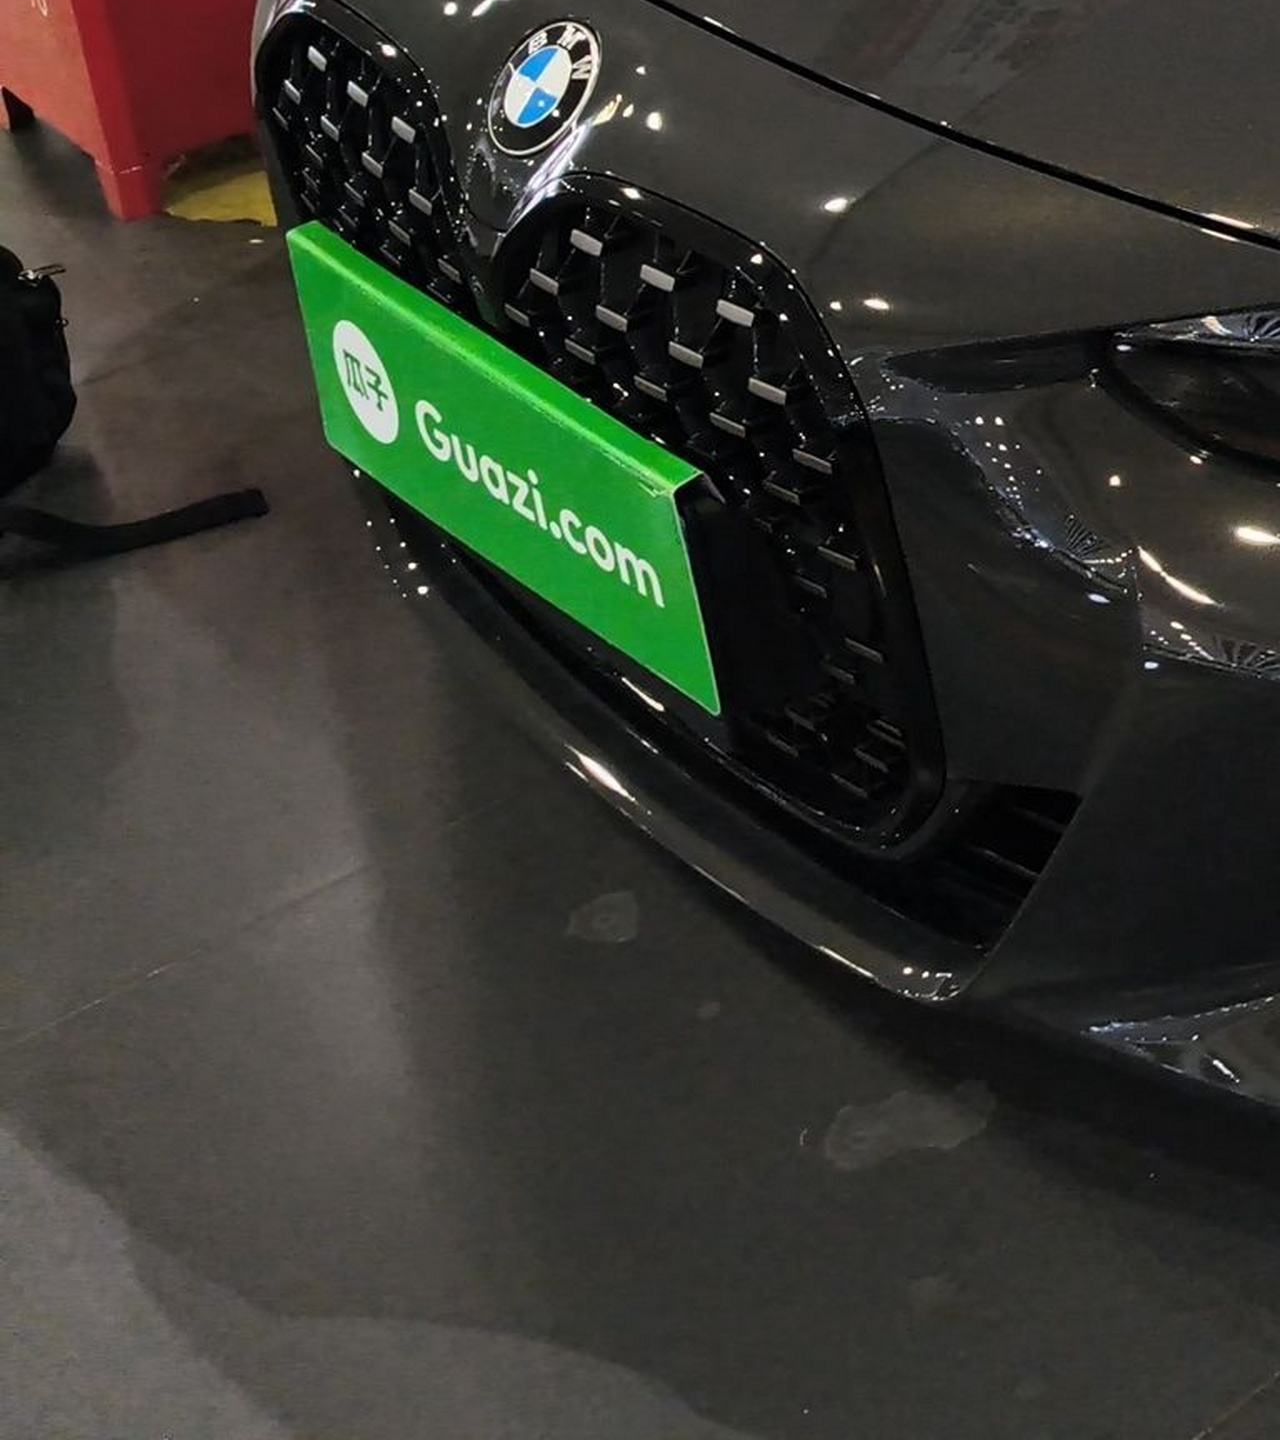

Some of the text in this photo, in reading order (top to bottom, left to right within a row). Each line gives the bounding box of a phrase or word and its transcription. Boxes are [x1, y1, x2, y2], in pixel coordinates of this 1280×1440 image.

[527, 23, 593, 80] BMW
[343, 348, 666, 609] 瓜子 Guazi.com
